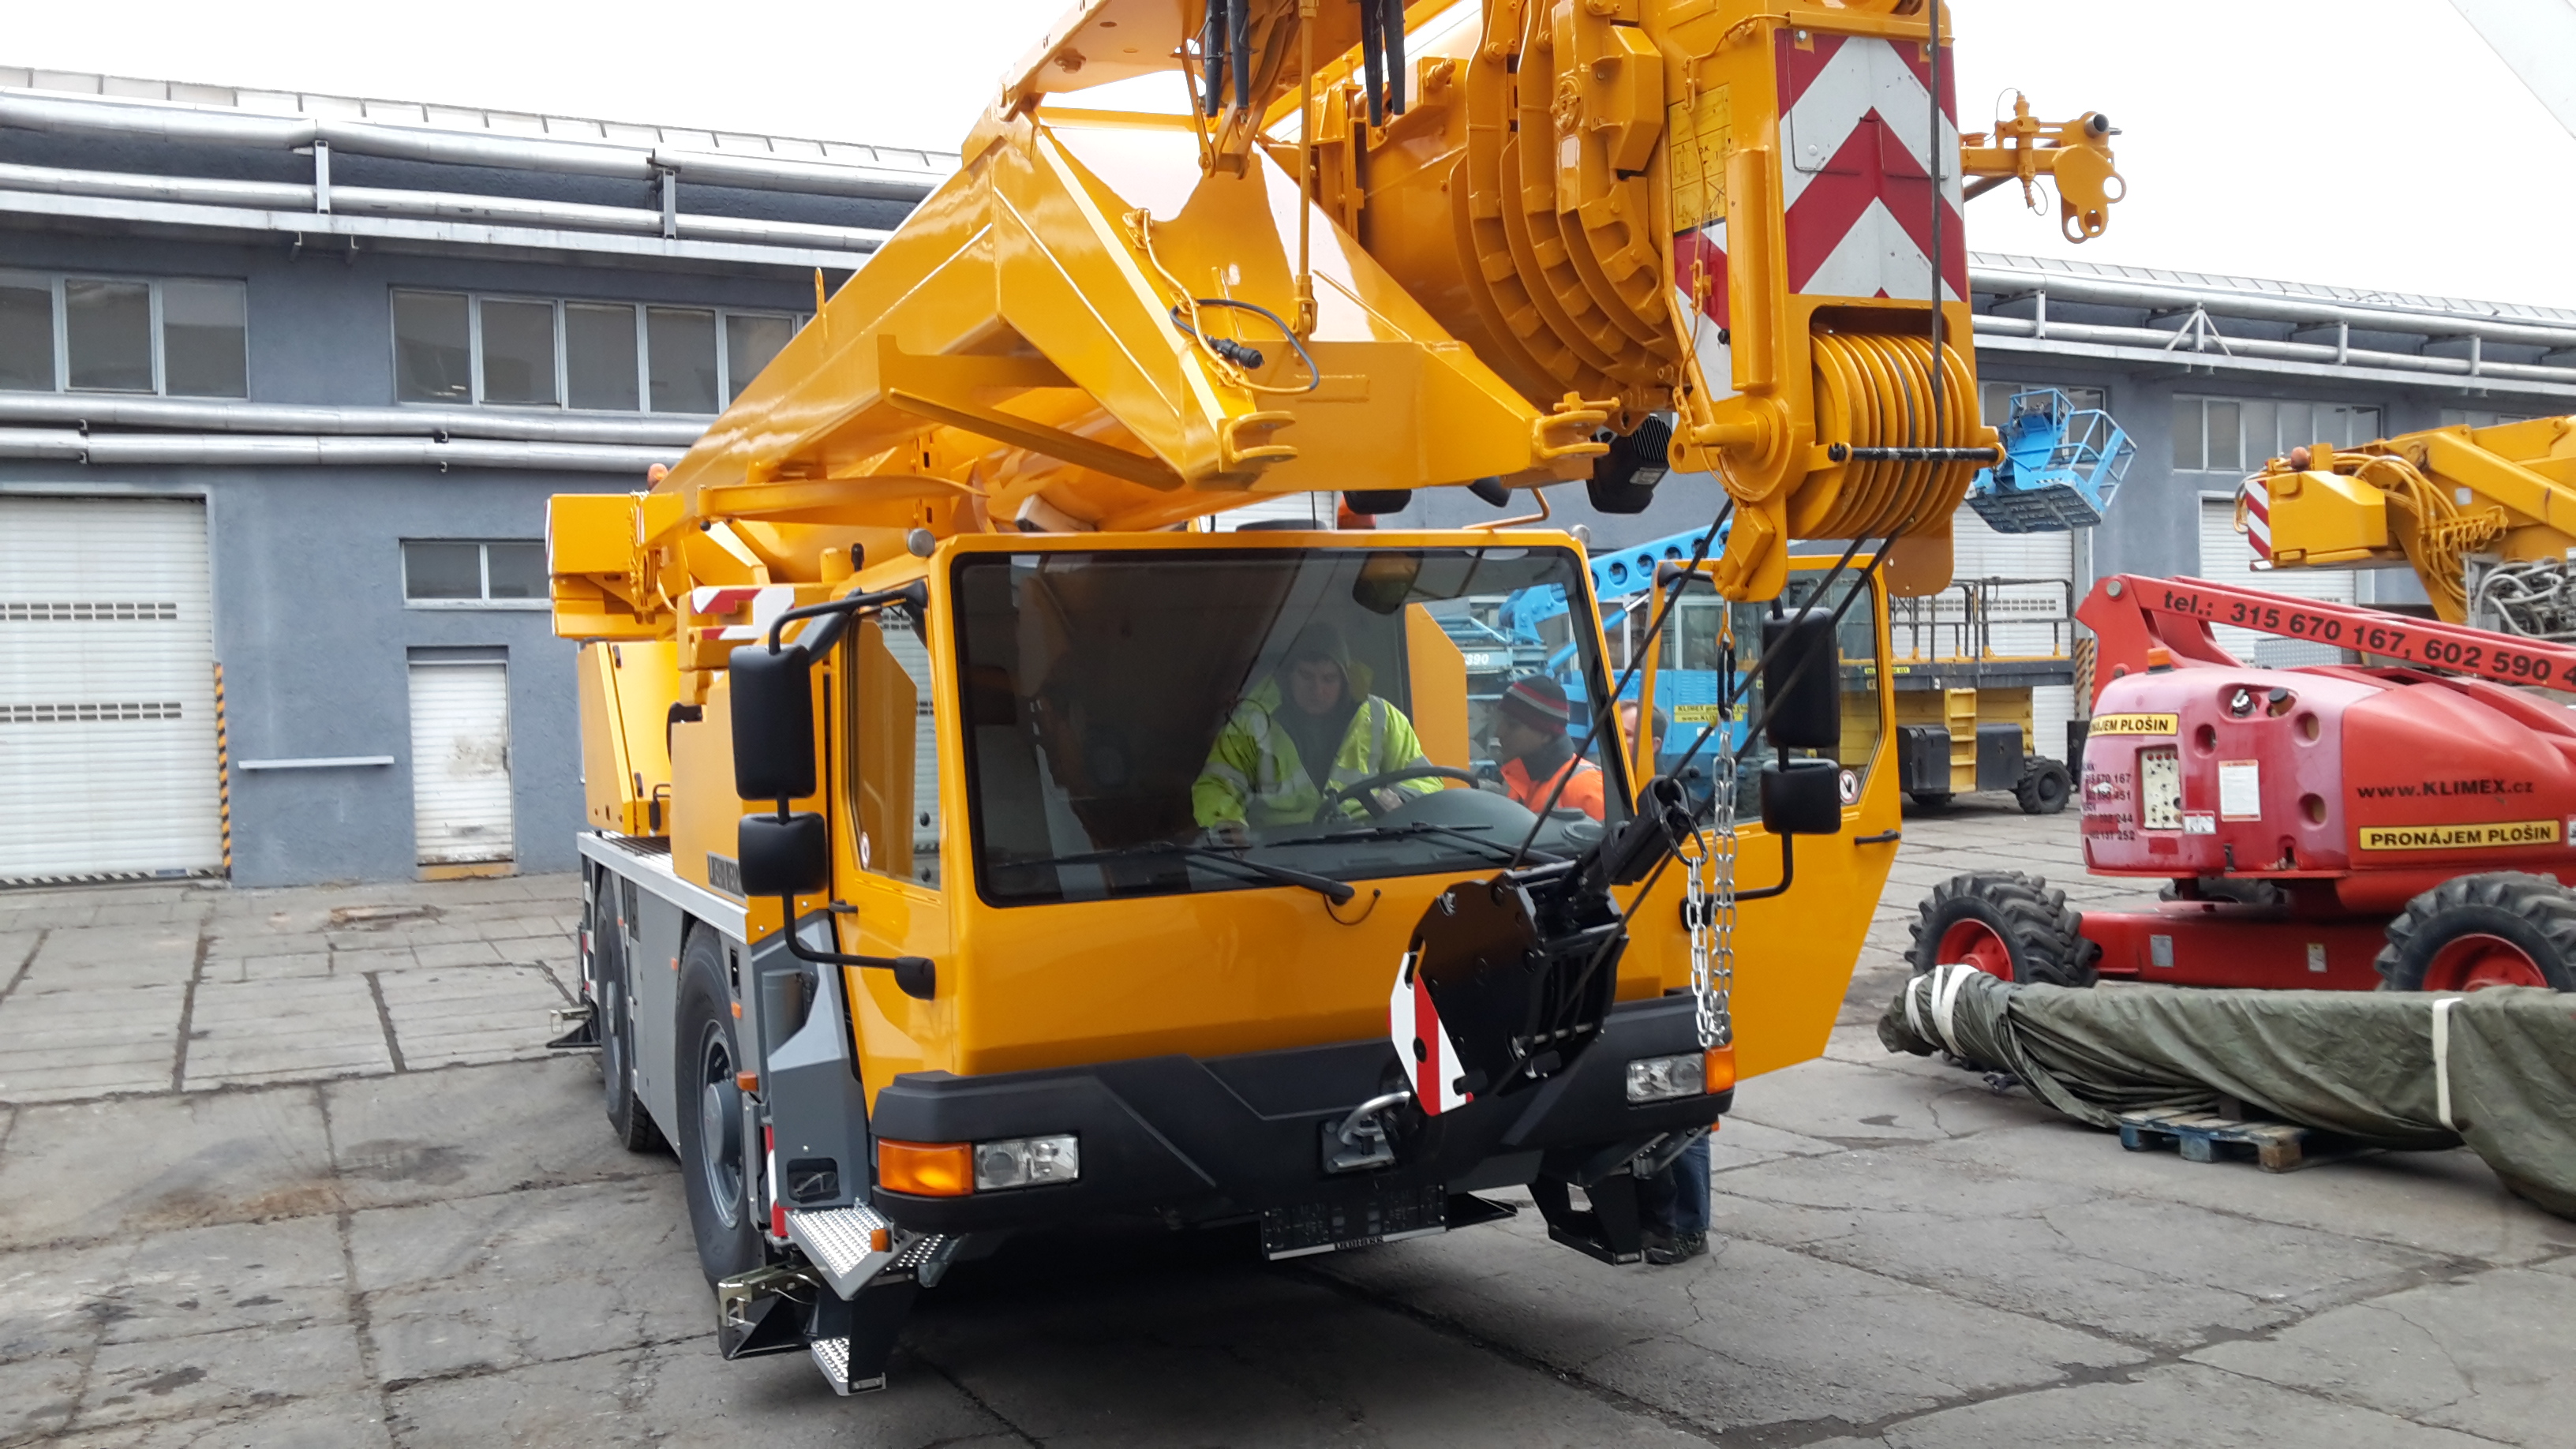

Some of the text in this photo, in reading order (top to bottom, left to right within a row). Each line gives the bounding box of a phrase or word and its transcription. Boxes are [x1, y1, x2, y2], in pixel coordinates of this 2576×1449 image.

[2164, 590, 2214, 616] tel.:
[2230, 602, 2281, 629] 315
[2290, 613, 2342, 641] 670
[2354, 625, 2412, 660] 167,
[2424, 638, 2483, 668] 602
[2492, 651, 2553, 681] 590
[2121, 716, 2169, 732] PLOŠIN
[2114, 773, 2132, 784] 167
[2357, 779, 2534, 798] www.KLIMEX.cz
[2370, 827, 2482, 846] PRONÁJEM
[2488, 825, 2552, 842] PLOŠIN
